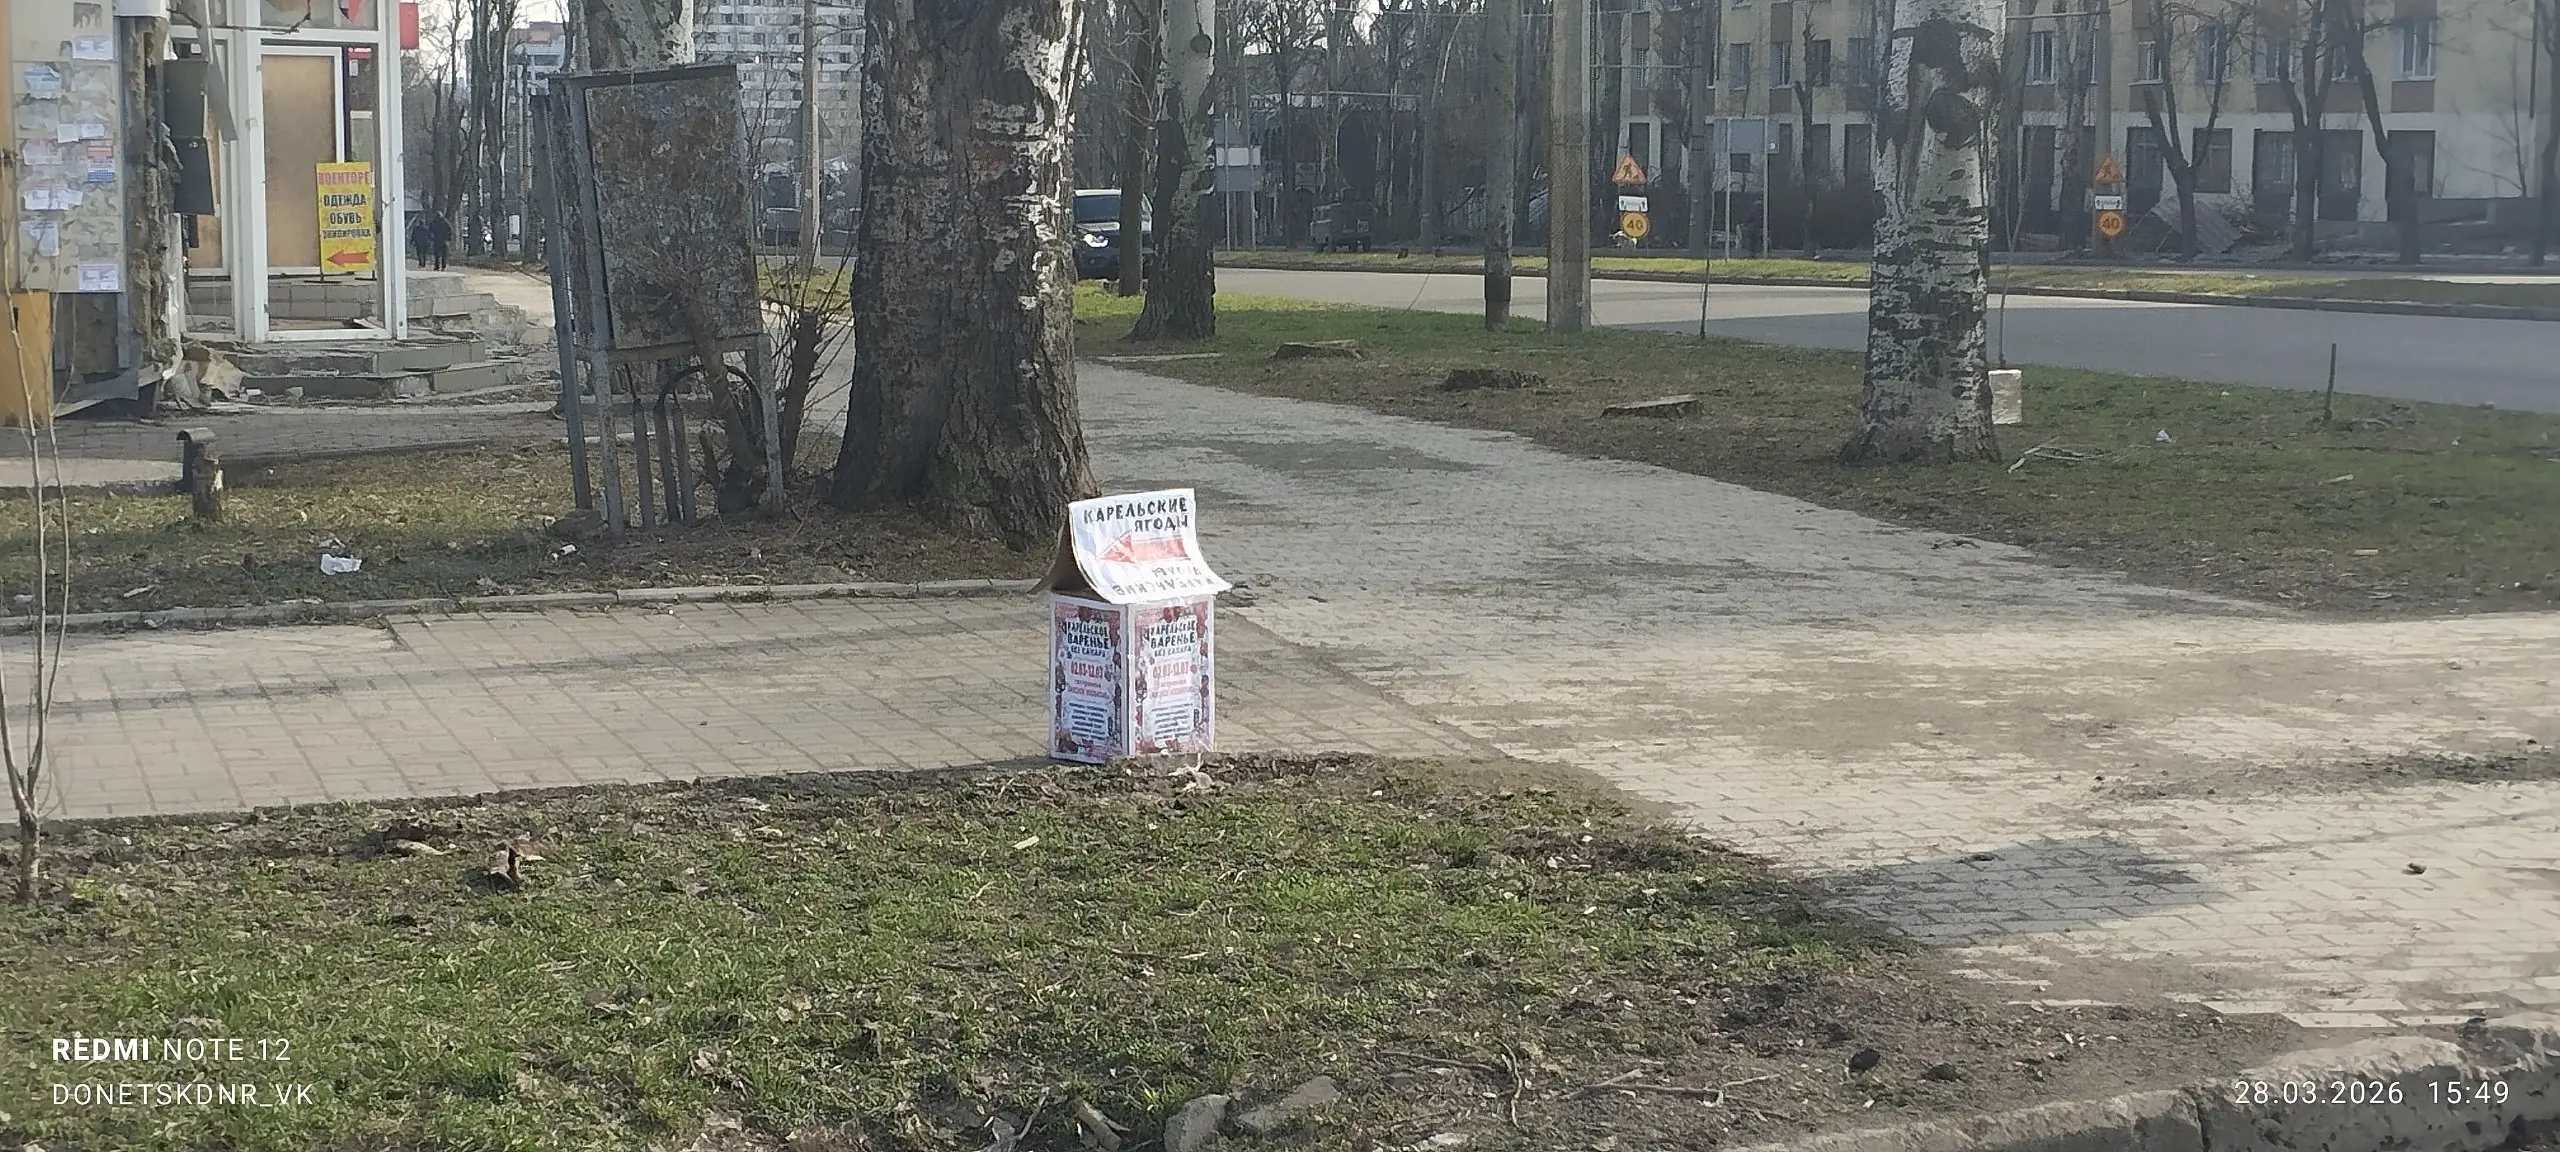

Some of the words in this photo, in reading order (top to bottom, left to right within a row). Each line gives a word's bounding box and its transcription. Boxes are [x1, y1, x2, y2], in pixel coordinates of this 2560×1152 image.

[318, 171, 370, 184] ВОЕНТОРГ
[324, 193, 367, 207] ОДЕЖДА
[329, 212, 362, 225] ОБУВЬ
[1627, 219, 1643, 230] 40
[2103, 218, 2120, 229] 40
[1083, 497, 1188, 524] КАРЕЛЬСКИЕ
[1134, 514, 1188, 533] ЯГОДЫ
[1067, 620, 1109, 638] КАРЕЛЬСКОЕ
[1151, 620, 1196, 639] КАРЕЛЬСКОЕ
[1067, 632, 1110, 649] ВАРЕНЬЕ
[1150, 631, 1196, 649] ВАРЕНЬЕ
